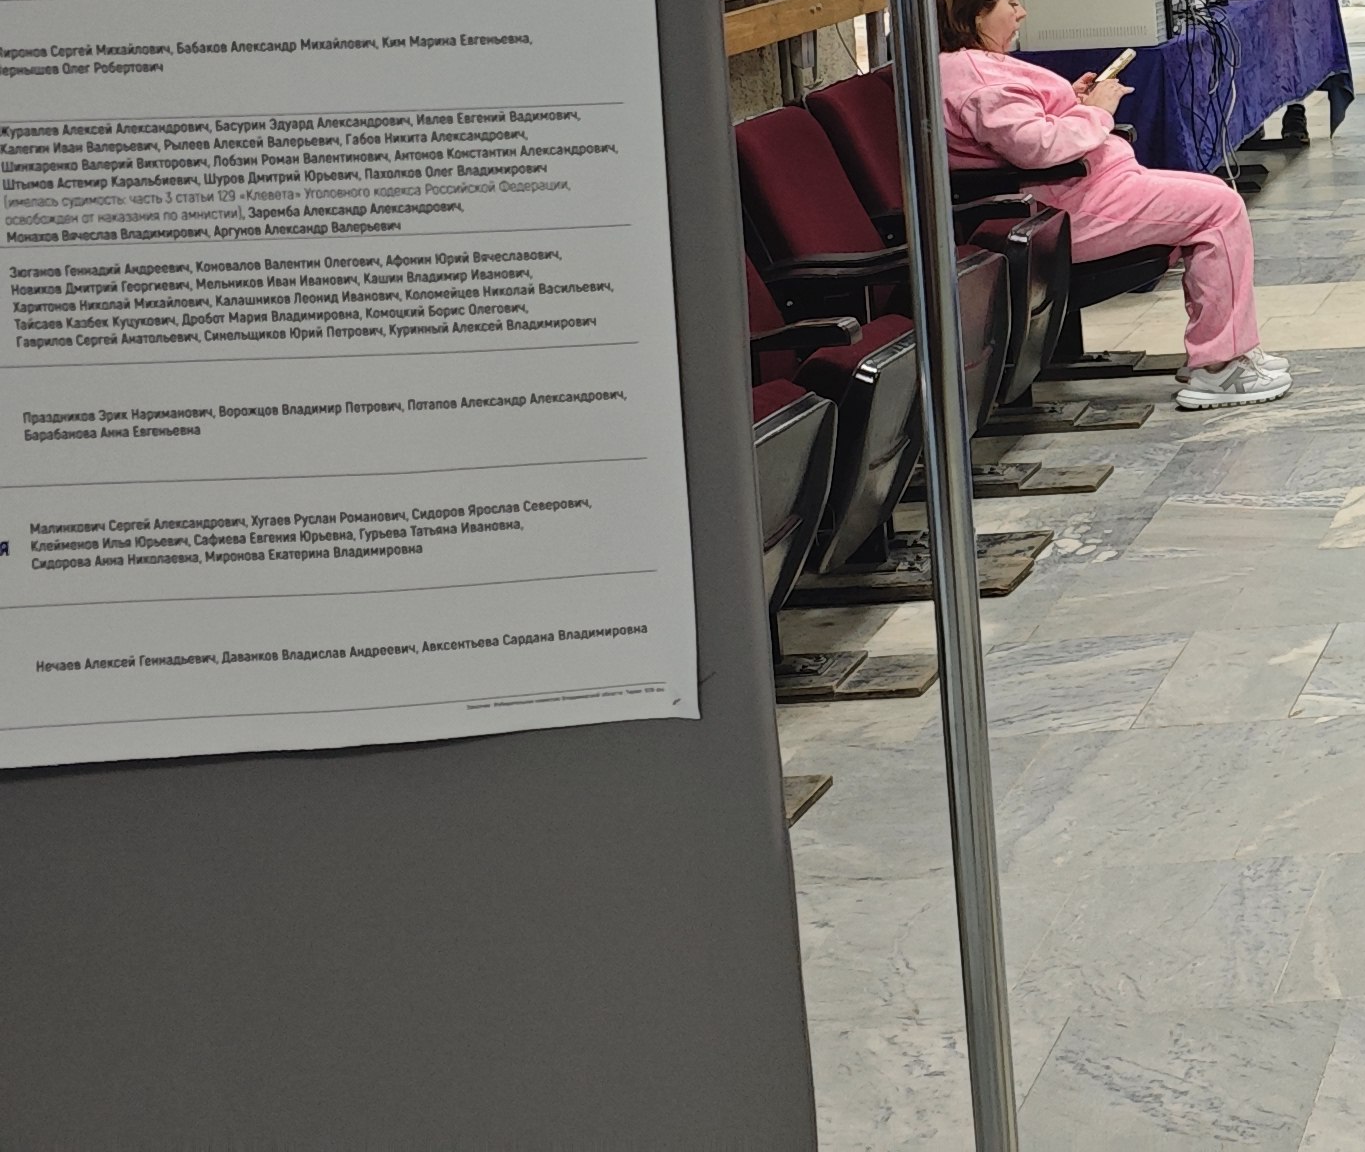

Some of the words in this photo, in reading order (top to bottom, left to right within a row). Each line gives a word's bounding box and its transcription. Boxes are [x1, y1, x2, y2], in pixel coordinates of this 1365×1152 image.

[214, 119, 266, 132] Басурин
[268, 117, 314, 131] Эдуард
[316, 116, 413, 128] Александрович,
[416, 113, 454, 125] Ивлев
[456, 110, 506, 124] Евгений
[508, 110, 581, 122] Вадимович,
[163, 138, 210, 150] Рылеев
[213, 136, 264, 149] Алексей
[267, 135, 342, 148] Валерьевич,
[345, 132, 381, 145] Габов
[384, 132, 428, 144] Никита
[430, 129, 528, 142] Александрович,
[135, 157, 210, 169] Викторович,
[213, 153, 258, 167] Лобзин
[260, 153, 299, 165] Роман
[302, 151, 391, 164] Валентинович,
[394, 149, 444, 161] Антонов
[446, 147, 517, 159] Константин
[519, 143, 618, 156] Александрович,
[203, 172, 245, 186] Шуров
[247, 169, 301, 184] Дмитрий
[304, 169, 362, 182] Юрьевич,
[364, 167, 422, 179] Пахолков
[424, 164, 453, 178] Олег
[456, 163, 547, 176] Владимирович
[124, 263, 193, 275] Андреевич,
[195, 260, 261, 272] Коновалов
[264, 258, 321, 270] Валентин
[323, 256, 383, 268] Олегович,
[385, 254, 432, 266] Афонин
[434, 251, 469, 265] Юрий
[472, 249, 562, 263] Вячеславович,
[195, 277, 264, 289] Мельников
[266, 275, 296, 287] Иван
[299, 274, 360, 286] Иванович,
[363, 272, 403, 284] Кашин
[406, 271, 467, 283] Владимир
[470, 268, 533, 280] Иванович,
[133, 296, 212, 309] Михайлович,
[215, 294, 291, 306] Калашников
[293, 291, 339, 304] Леонид
[341, 290, 402, 302] Иванович,
[404, 287, 480, 300] Коломейцев
[482, 283, 535, 296] Николай
[538, 281, 614, 294] Васильевич,
[181, 311, 225, 326] Дробот
[228, 311, 268, 323] Мария
[270, 309, 362, 322] Владимировна,
[365, 305, 425, 319] Комоцкий
[427, 304, 465, 317] Борис
[467, 303, 529, 315] Олегович,
[130, 407, 216, 421] Нариманович,
[218, 405, 279, 417] Ворожцов
[281, 403, 342, 415] Владимир
[344, 400, 404, 414] Петрович,
[407, 398, 457, 411] Потапов
[460, 395, 527, 408] Александр
[529, 390, 627, 404] Александрович,
[127, 553, 202, 565] Николаевна,
[204, 550, 265, 562] Миронова
[267, 548, 330, 560] Екатерина
[333, 544, 423, 558] Владимировна
[138, 653, 219, 667] Геннадьевич,
[221, 650, 278, 664] Даванков
[281, 648, 346, 660] Владислав
[349, 644, 418, 658] Андреевич,
[422, 637, 499, 652] Авксентьева
[502, 631, 555, 645] Сардана
[557, 624, 648, 640] Владимировна
